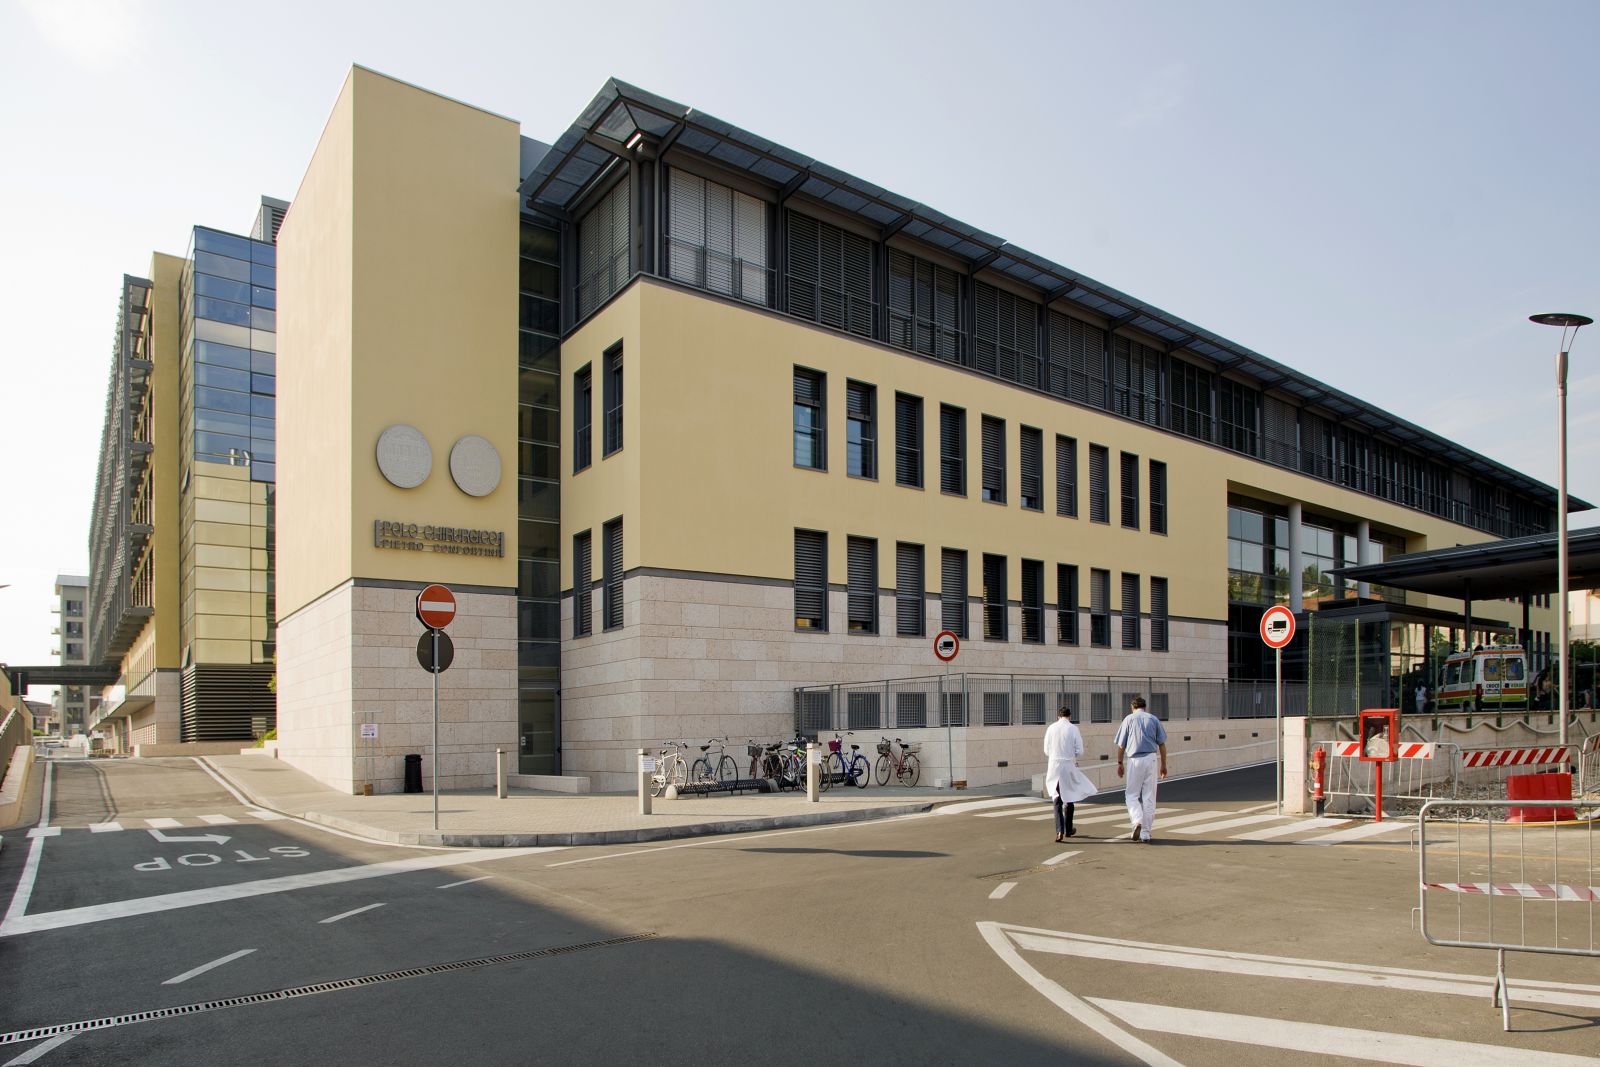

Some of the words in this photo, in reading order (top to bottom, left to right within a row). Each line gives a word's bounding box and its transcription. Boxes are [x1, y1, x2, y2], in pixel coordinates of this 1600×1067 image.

[382, 521, 418, 539] POLO
[423, 525, 498, 545] CHIRURGICO
[382, 540, 424, 551] PIETRO
[132, 846, 311, 872] STOP
